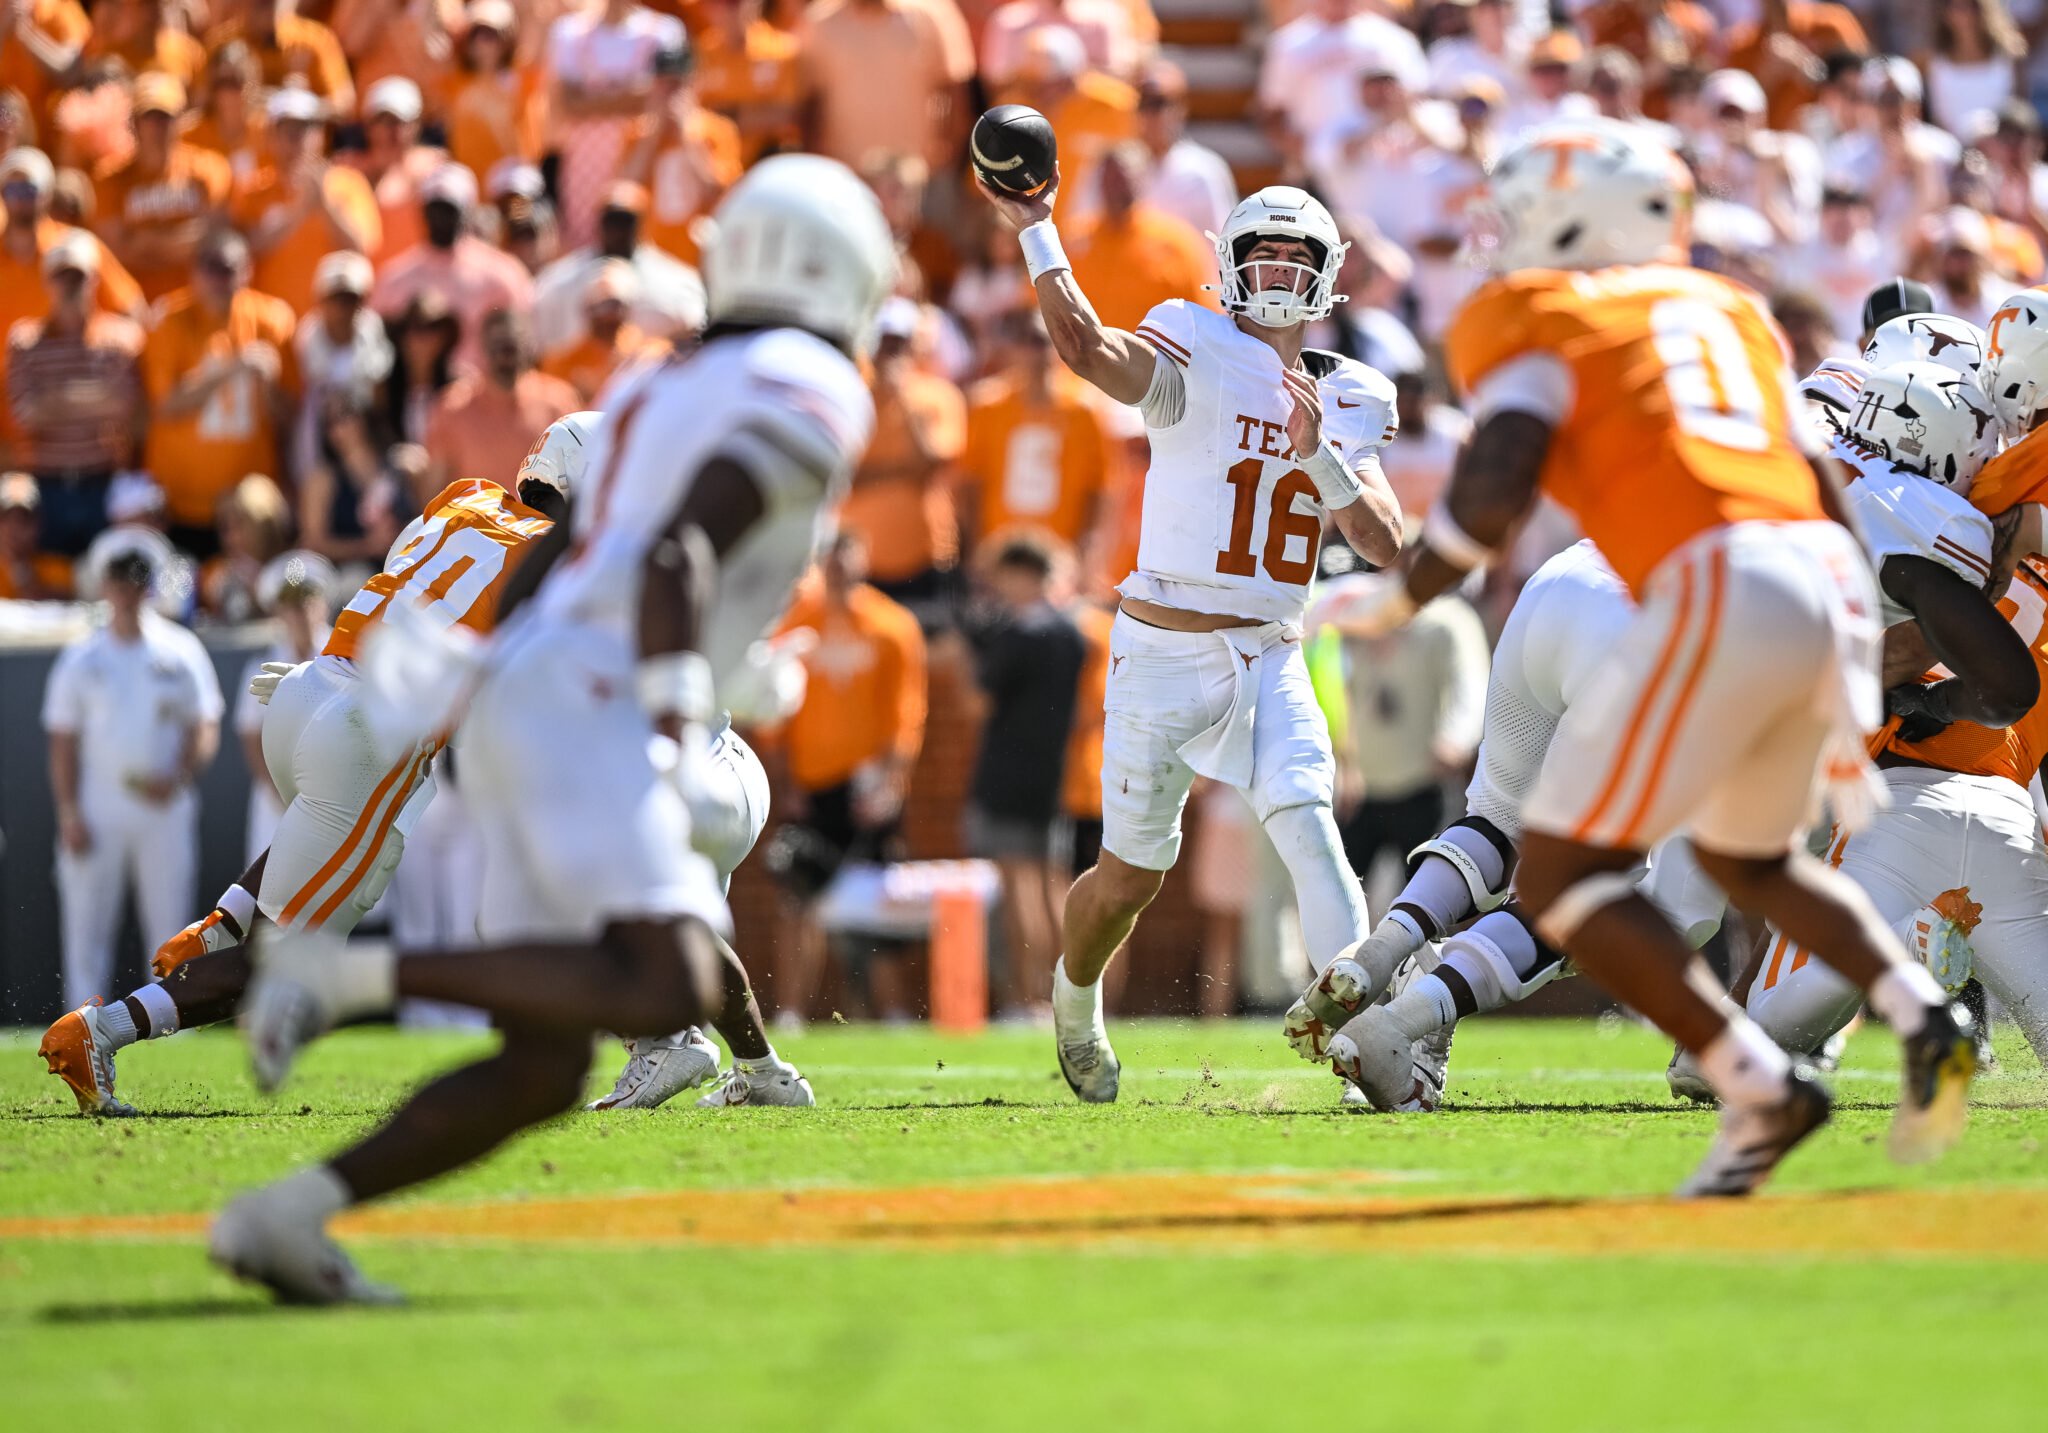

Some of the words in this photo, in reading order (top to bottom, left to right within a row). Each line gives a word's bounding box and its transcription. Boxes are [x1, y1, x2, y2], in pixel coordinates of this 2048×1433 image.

[1269, 214, 1296, 223] HORNS
[1987, 307, 2021, 360] T
[1650, 299, 1771, 451] 0
[1854, 391, 1885, 431] 71
[1235, 414, 1343, 462] TEX
[1216, 457, 1322, 587] 16
[1441, 844, 1476, 872] DONJOY
